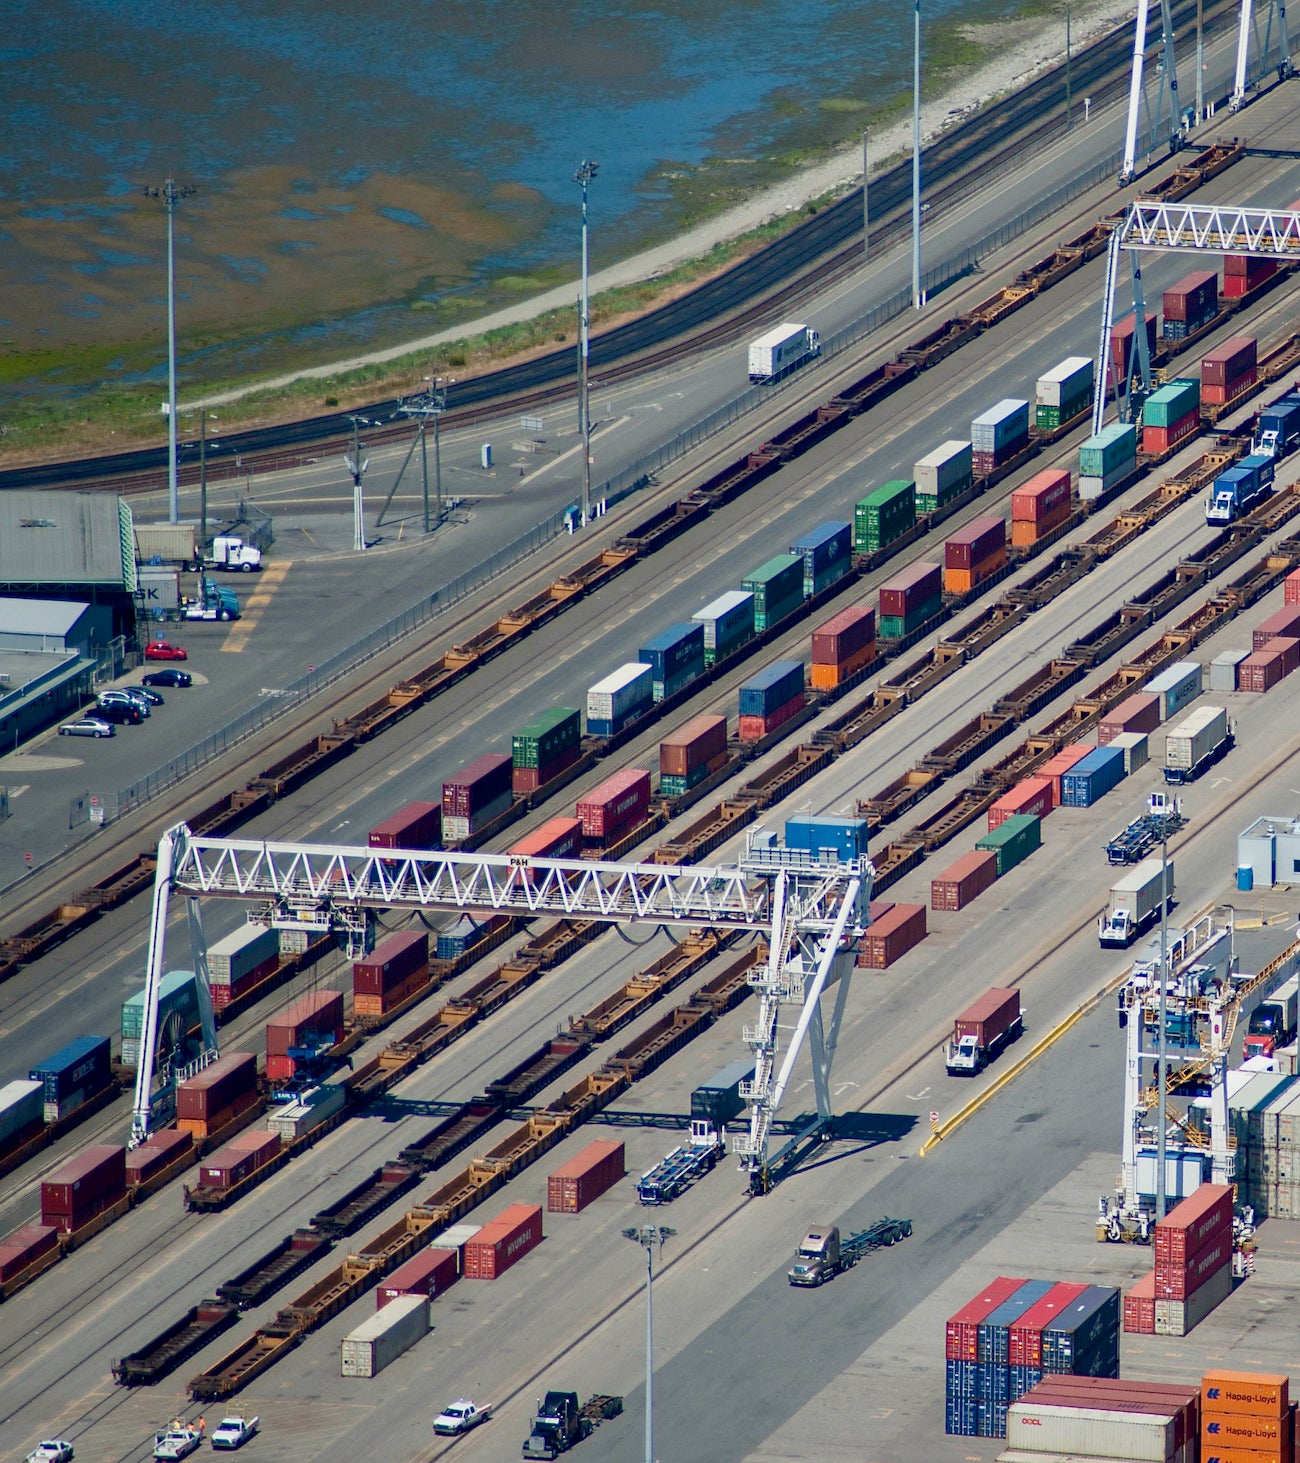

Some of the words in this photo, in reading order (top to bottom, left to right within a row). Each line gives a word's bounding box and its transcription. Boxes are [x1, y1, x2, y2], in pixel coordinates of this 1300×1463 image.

[1170, 80, 1178, 91] 6
[510, 858, 528, 867] P&H
[1225, 1391, 1276, 1403] Hapag-Lloyd
[1021, 1417, 1042, 1426] OOCL
[1226, 1426, 1277, 1438] Hapag-Lloyd
